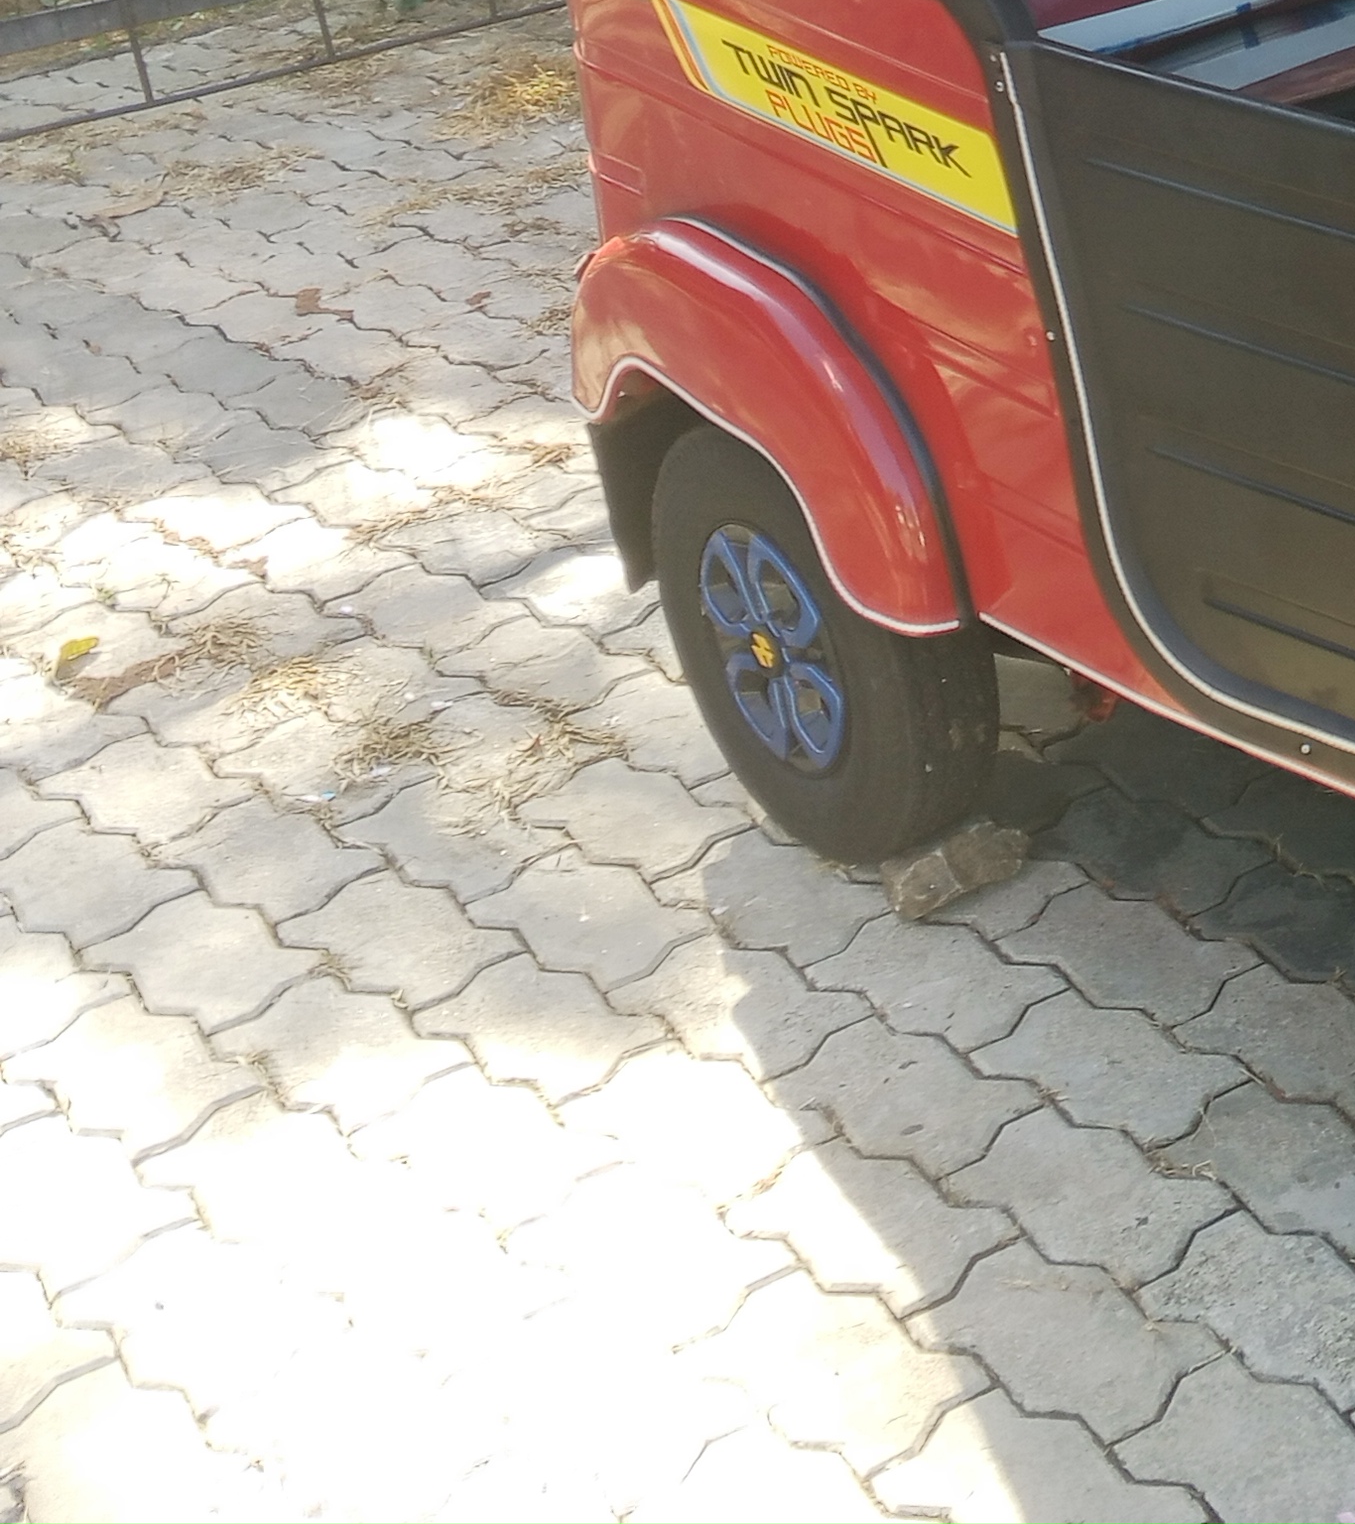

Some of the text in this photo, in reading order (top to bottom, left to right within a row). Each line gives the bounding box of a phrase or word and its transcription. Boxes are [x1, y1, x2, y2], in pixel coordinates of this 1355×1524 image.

[721, 38, 973, 179] TWIN SPARK
[766, 44, 878, 105] POWERED BY
[765, 88, 878, 165] PLUGS
